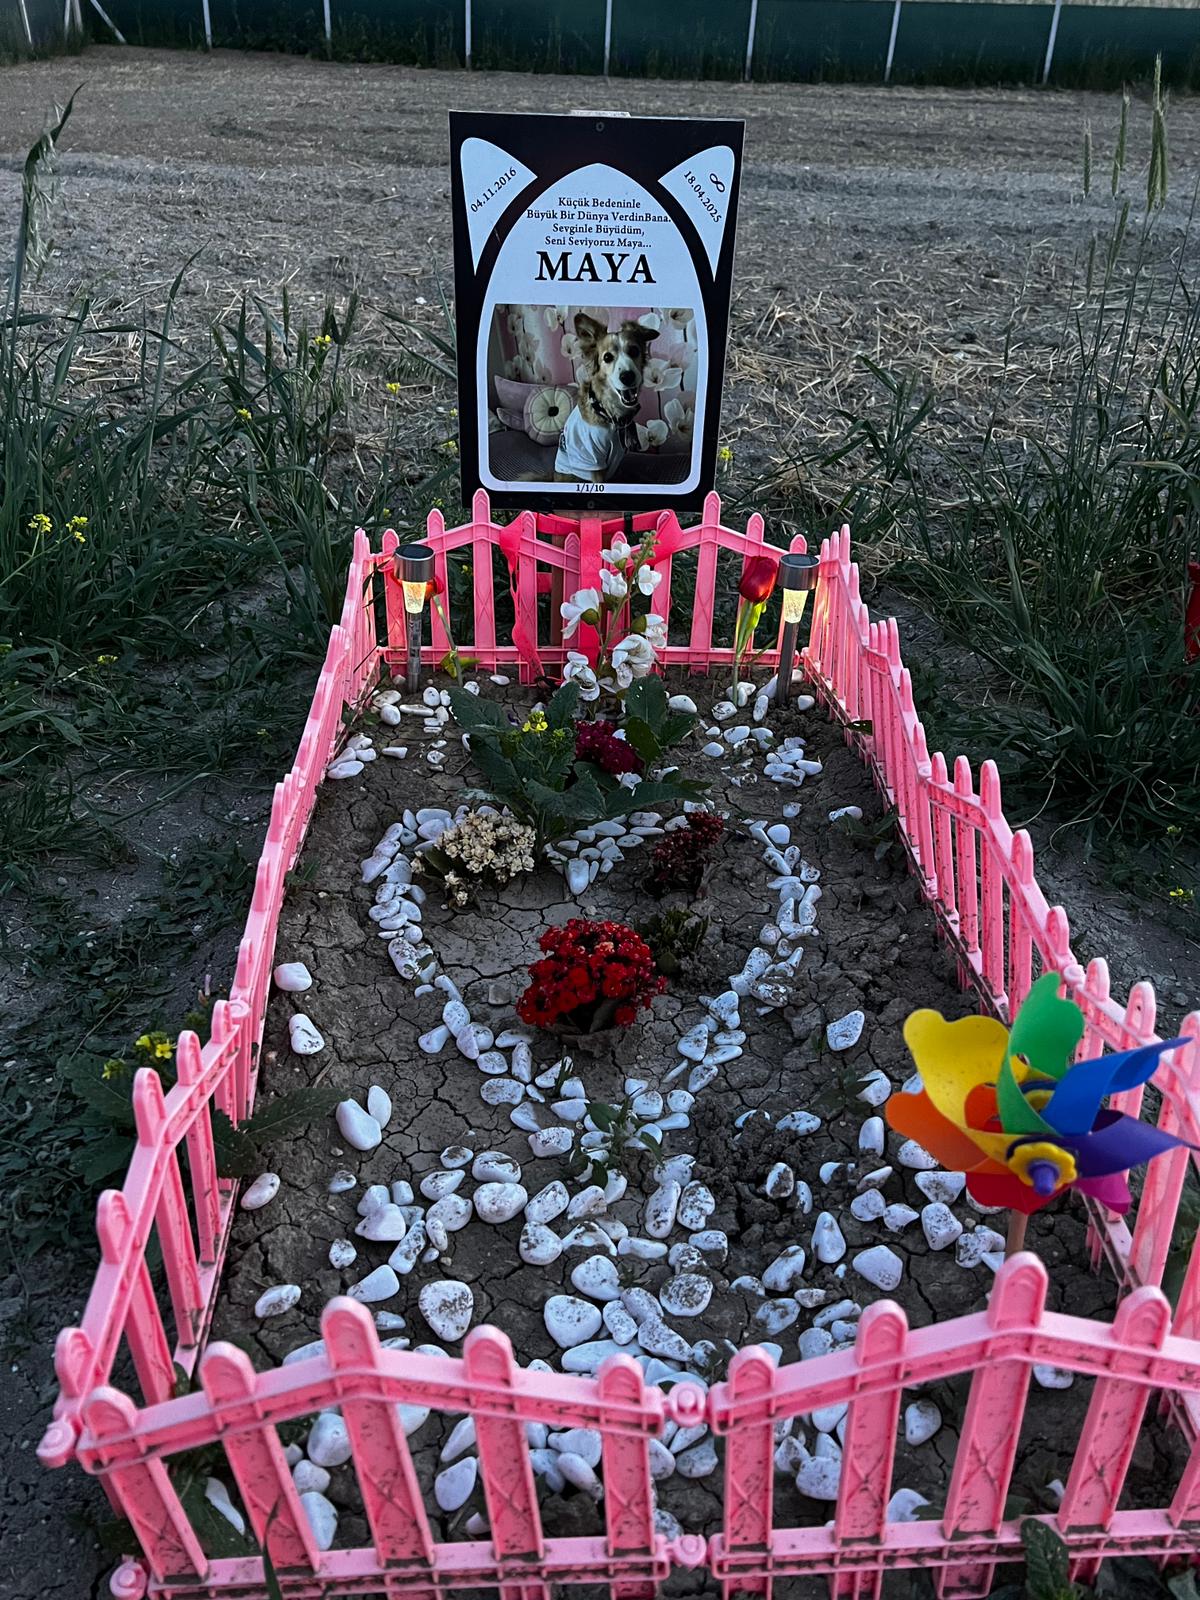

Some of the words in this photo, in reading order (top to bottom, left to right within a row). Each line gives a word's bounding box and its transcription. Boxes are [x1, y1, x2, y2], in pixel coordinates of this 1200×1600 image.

[470, 167, 517, 212] 04.11.2016
[558, 197, 590, 209] Küçük
[592, 198, 641, 208] Bedeninle
[683, 171, 722, 222] 18.04.2025
[526, 210, 558, 221] Büyük
[560, 210, 575, 219] Bir
[577, 211, 609, 221] Dünya
[552, 223, 593, 235] Sevginle
[595, 224, 645, 236] Büyüdüm,
[545, 236, 566, 245] Seni
[568, 236, 615, 249] Seviyoruz
[617, 238, 652, 249] Maya...
[534, 251, 656, 284] MAYA
[576, 483, 605, 494] 1/1/10
